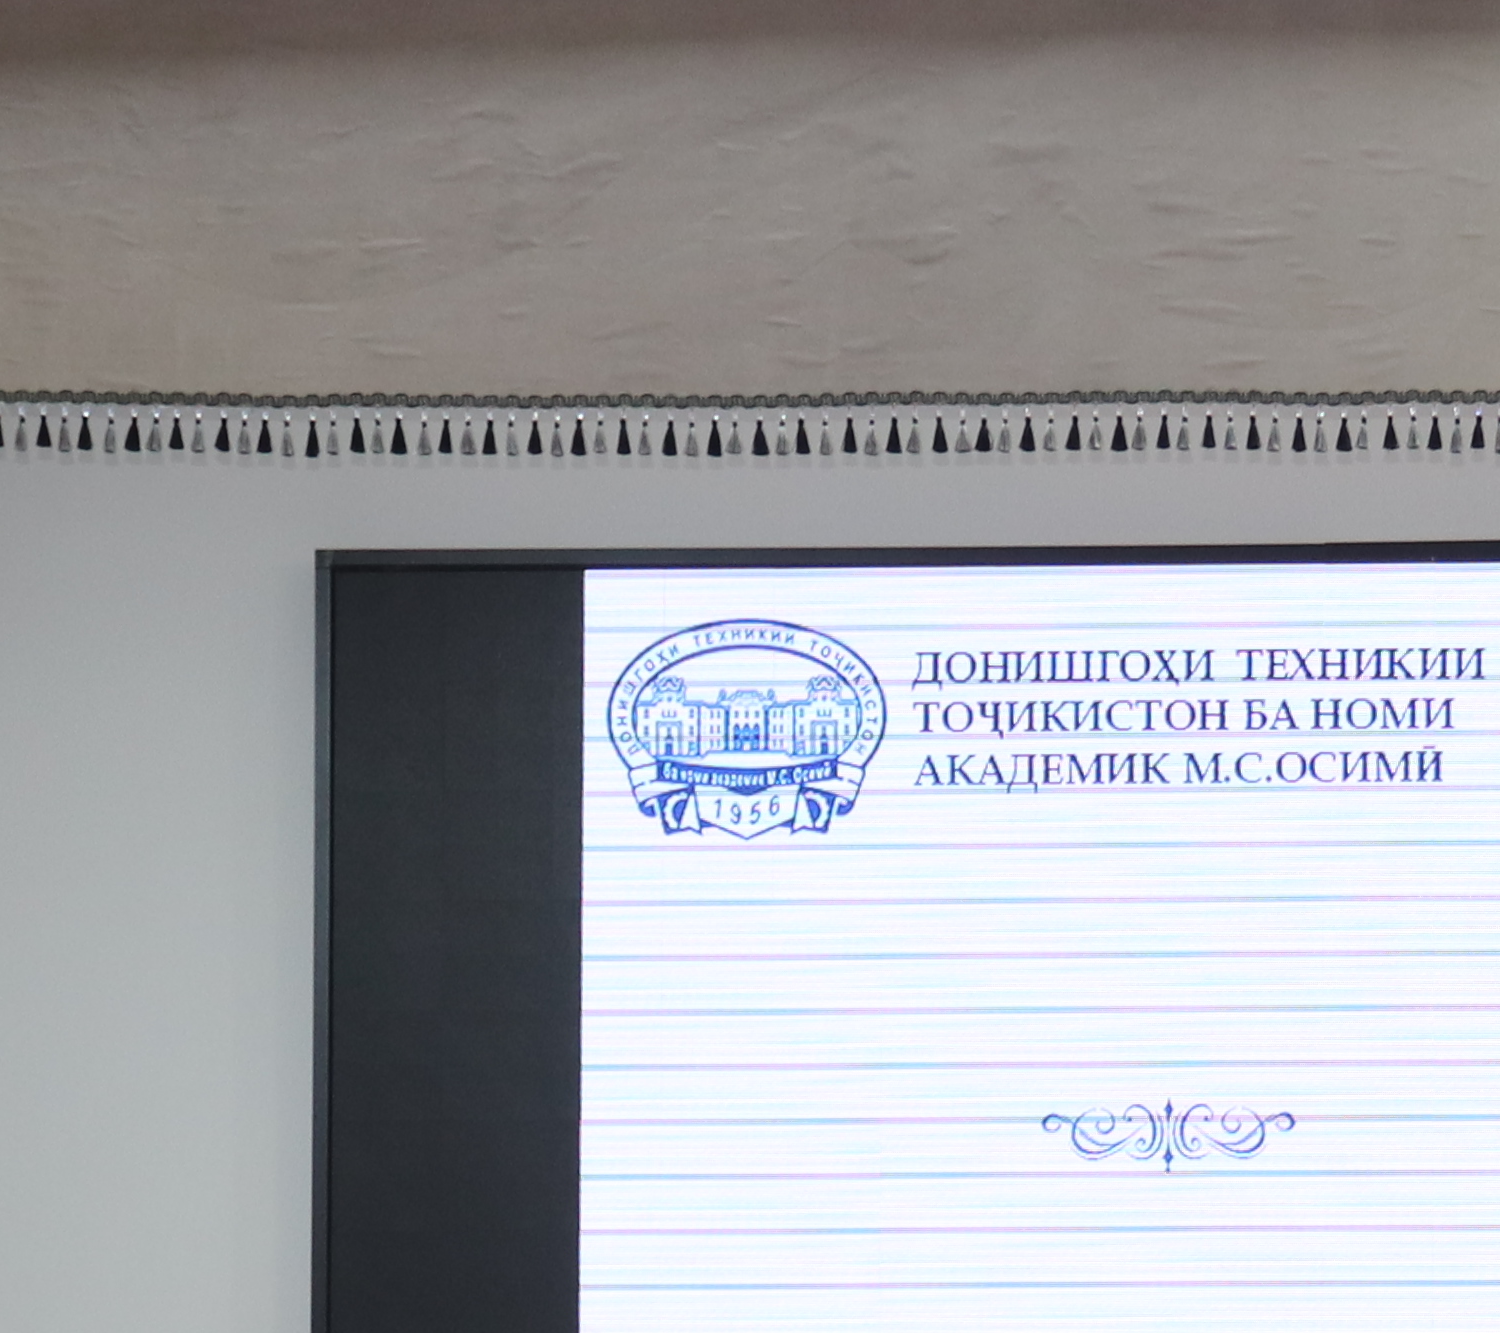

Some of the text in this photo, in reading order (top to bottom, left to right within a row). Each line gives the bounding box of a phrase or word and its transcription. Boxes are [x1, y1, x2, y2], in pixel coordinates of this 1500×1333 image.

[911, 648, 1485, 690] ДОНИШГОҲИ ТЕХНИКИИ
[913, 698, 1455, 738] ТОҶИКИСТОН БА НОМИ
[914, 753, 1171, 793] АКАДЕМИК
[713, 794, 781, 826] 1956
